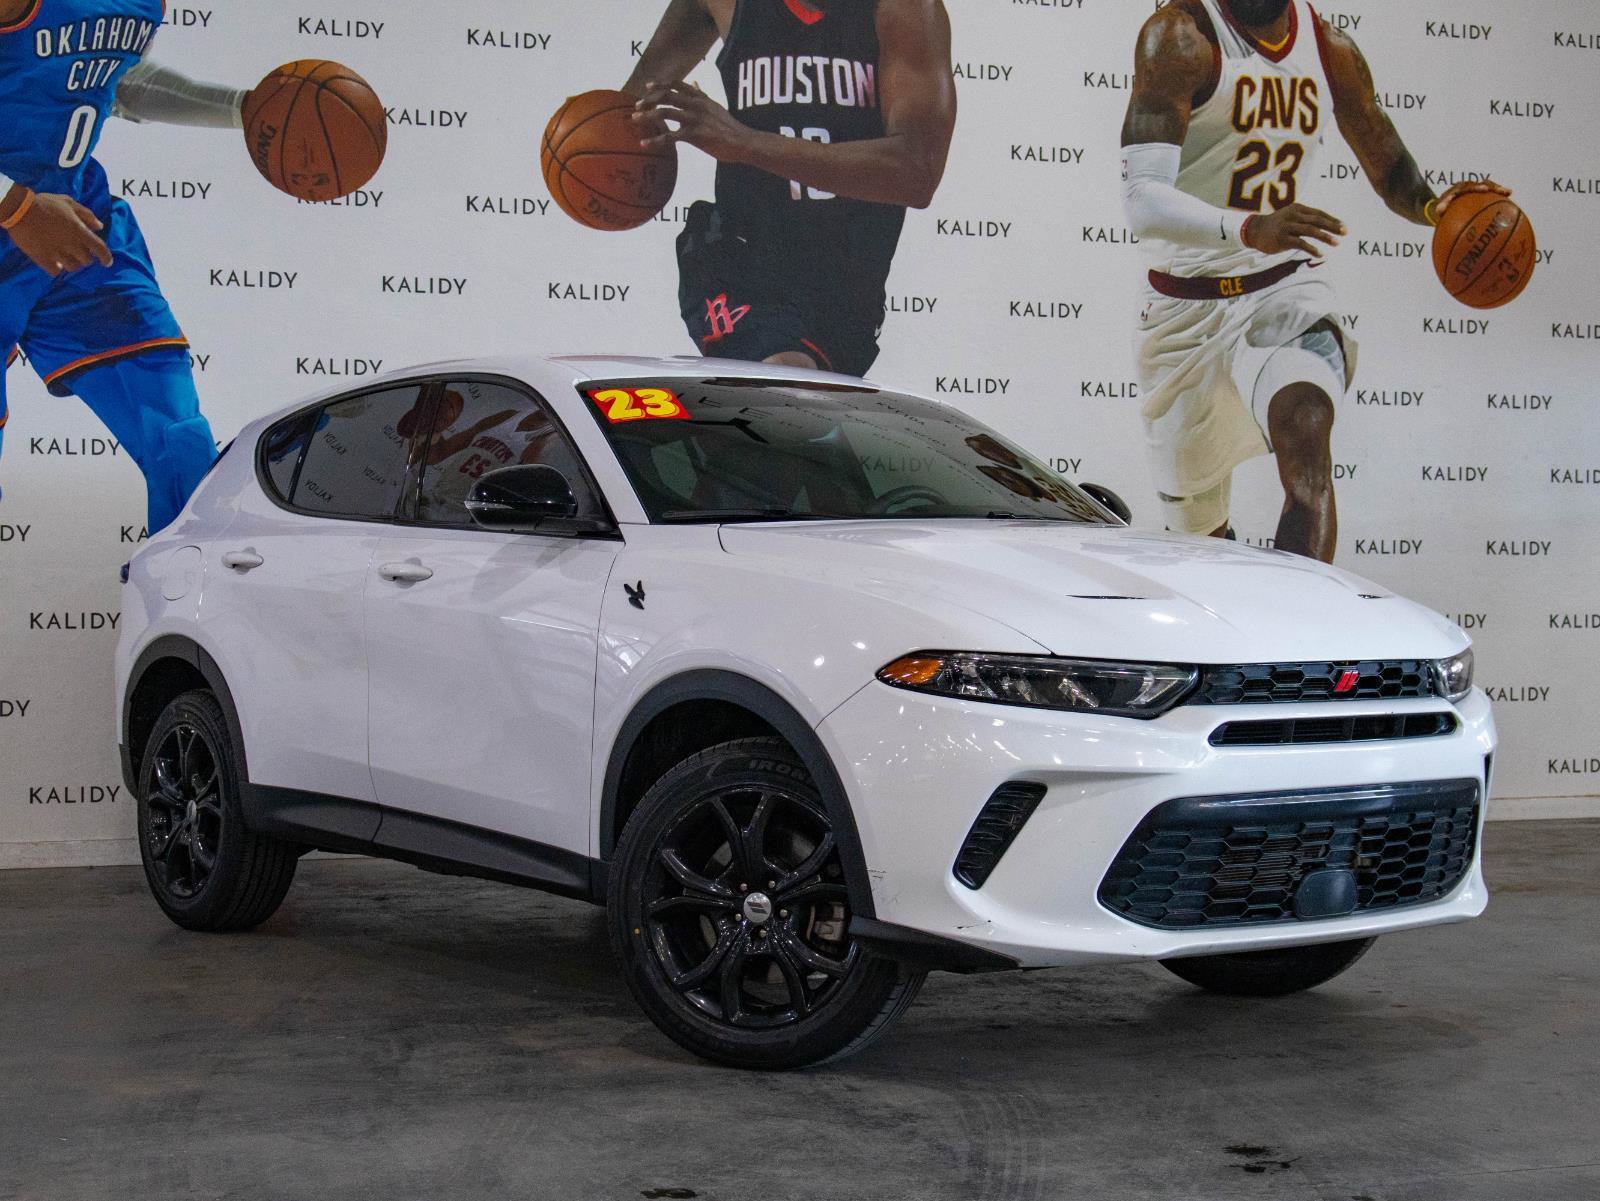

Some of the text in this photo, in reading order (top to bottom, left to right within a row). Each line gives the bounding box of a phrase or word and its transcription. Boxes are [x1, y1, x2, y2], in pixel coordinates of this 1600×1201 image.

[163, 9, 213, 27] IDY
[1320, 13, 1361, 31] IDY
[299, 17, 384, 38] KALIDY
[1426, 22, 1491, 40] KALIDY
[36, 17, 153, 57] OKLAHOM
[468, 29, 551, 50] KALIDY
[1555, 32, 1600, 49] KALI
[67, 59, 121, 90] CITY
[954, 63, 1012, 80] ALIDY
[738, 56, 875, 110] HOUSTON
[1084, 72, 1134, 91] KALI
[1232, 76, 1319, 135] CAVS
[1375, 93, 1427, 111] ALIDY
[1491, 100, 1554, 118] KALIDY
[385, 107, 467, 128] KALIDY
[58, 105, 97, 169] 0
[1012, 145, 1083, 163] KALIDY
[1227, 139, 1305, 212] 23
[1321, 164, 1360, 180] IDY
[1425, 170, 1490, 188] KALIDY
[122, 179, 211, 199] KALIDY
[1553, 178, 1600, 194] KALI
[467, 196, 549, 215] KALIDY
[938, 220, 1011, 237] KALIDY
[1083, 227, 1139, 243] KALI
[1359, 241, 1424, 258] KALIDY
[211, 269, 297, 288] KALIDY
[383, 276, 466, 294] KALIDY
[1219, 276, 1244, 296] CLE
[549, 283, 629, 301] KALIDY
[885, 296, 937, 313] LIDY
[1010, 301, 1082, 318] KALIDY
[1424, 318, 1488, 334] KALIDY
[297, 358, 382, 375] KALIDY
[937, 377, 1009, 393] KALIDY
[1082, 382, 1137, 397] KALID
[594, 388, 681, 420] 23
[1357, 390, 1423, 405] KALIDY
[1488, 394, 1552, 409] KALIDY
[30, 438, 120, 456] KALIDY
[1050, 458, 1082, 474] IDY
[1423, 466, 1487, 481] KALIDY
[1551, 469, 1600, 483] KALID
[1356, 540, 1422, 554] KALIDY
[1487, 541, 1551, 555] KALIDY
[31, 613, 120, 629] KALIDY
[1447, 614, 1488, 629] IDY
[1550, 614, 1600, 628] KALID
[1486, 687, 1549, 701] KALIDY
[1549, 759, 1600, 773] KALID
[30, 786, 120, 804] KALIDY
